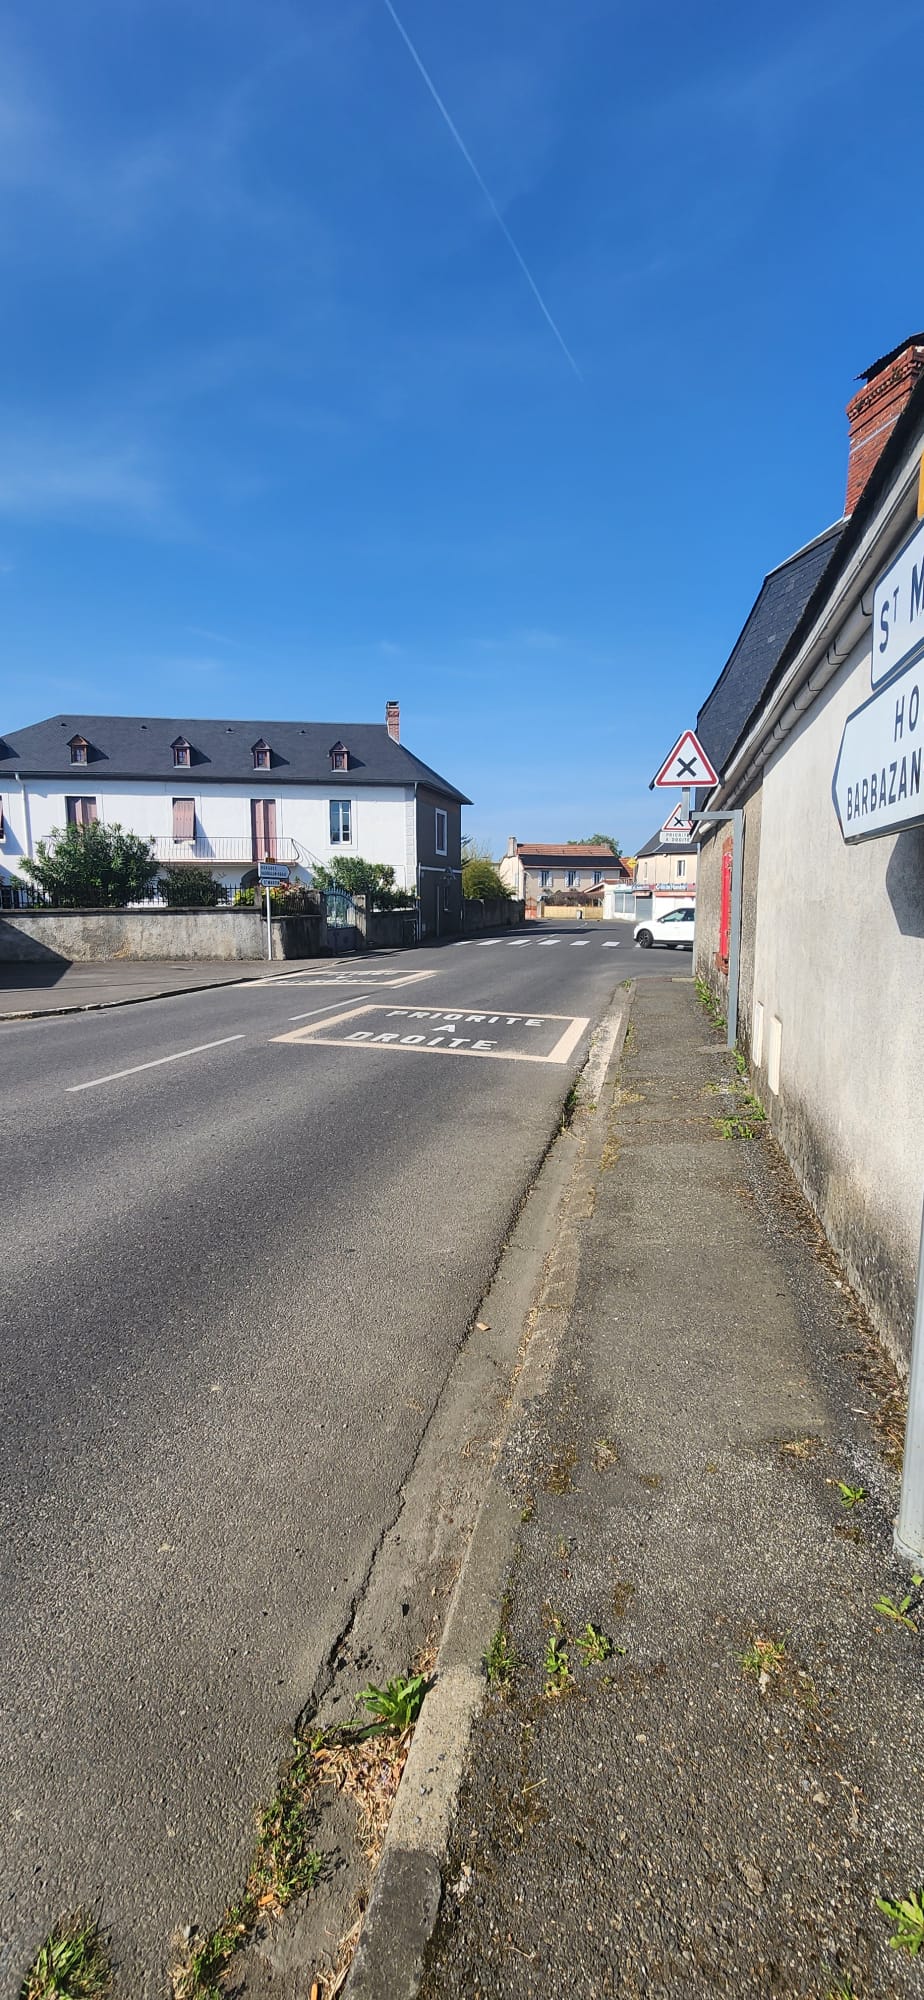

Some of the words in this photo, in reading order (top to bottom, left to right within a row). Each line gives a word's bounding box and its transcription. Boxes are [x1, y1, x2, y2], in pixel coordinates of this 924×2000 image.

[894, 685, 920, 743] HO
[847, 747, 922, 822] BARBAZAN
[386, 1010, 545, 1027] PRIORITE
[431, 1024, 456, 1033] A
[344, 1031, 498, 1050] DROITE
